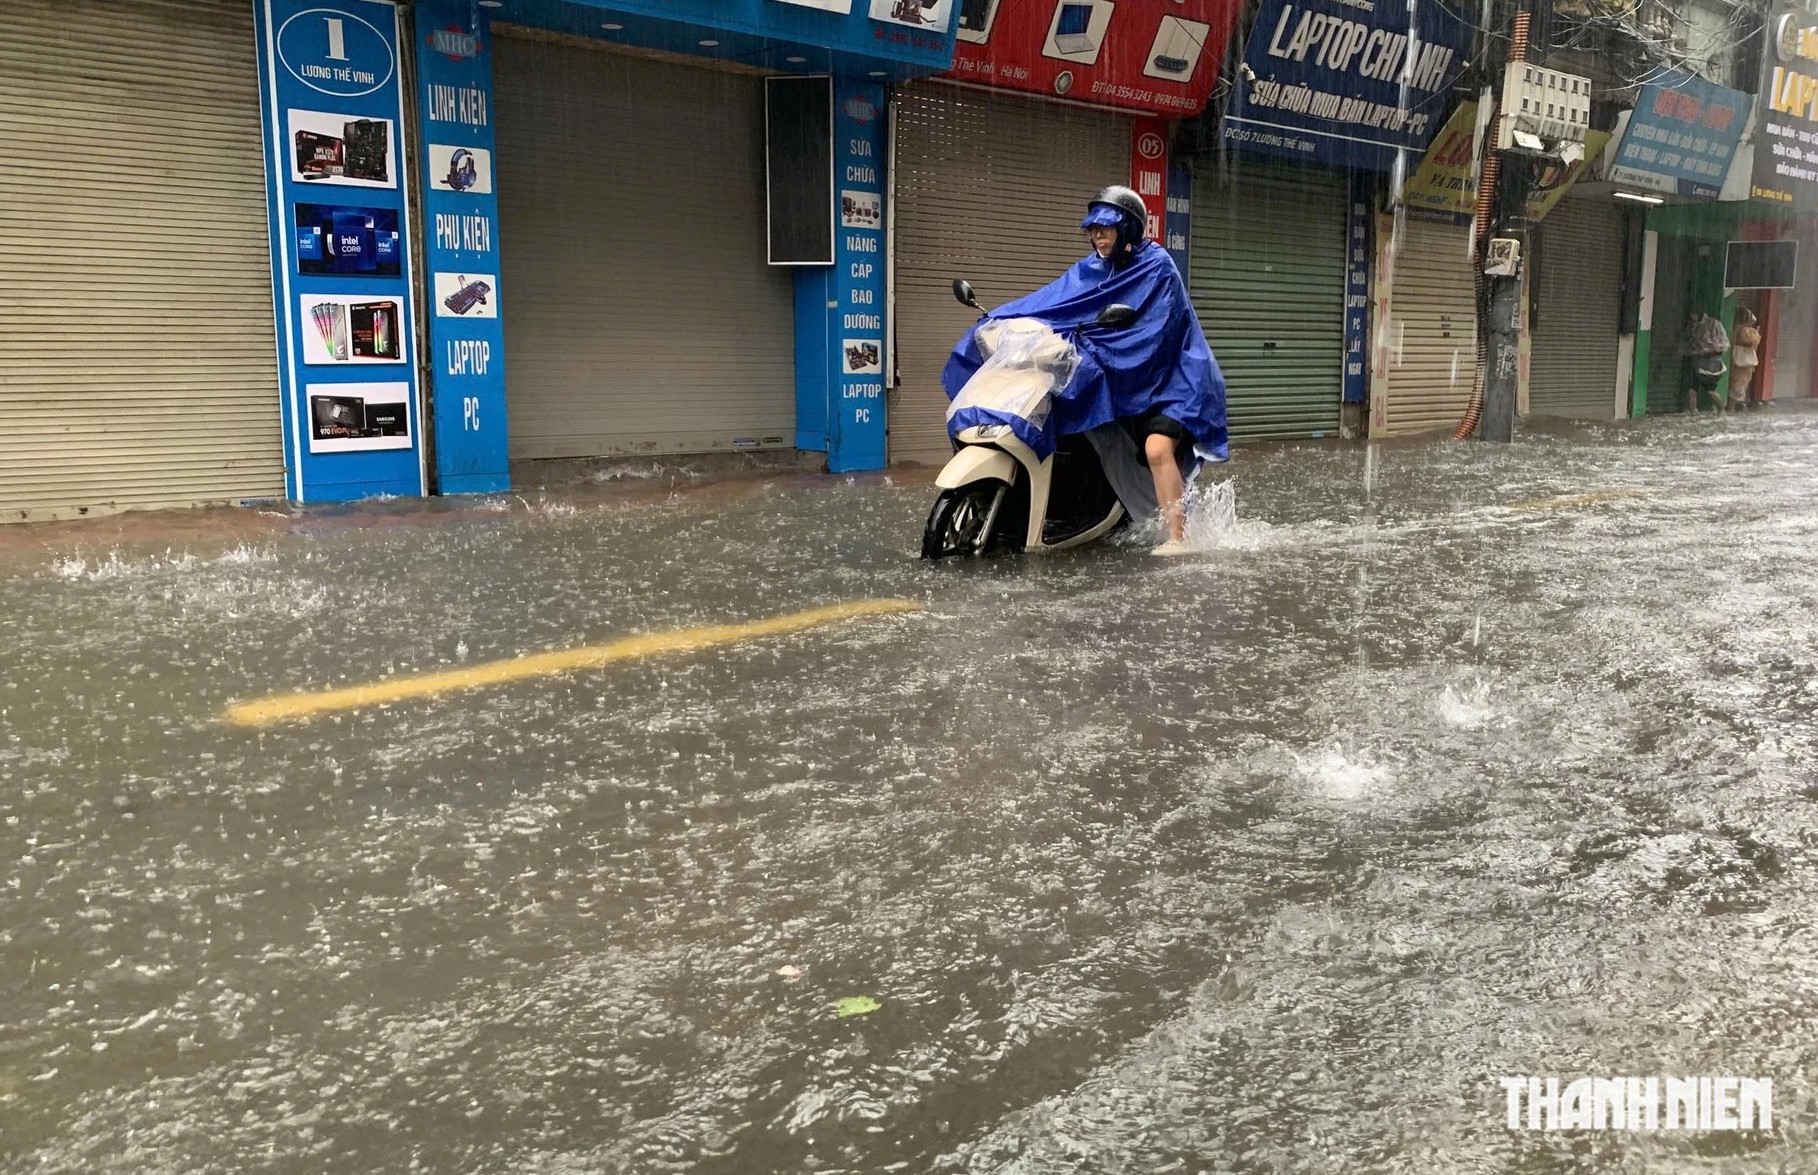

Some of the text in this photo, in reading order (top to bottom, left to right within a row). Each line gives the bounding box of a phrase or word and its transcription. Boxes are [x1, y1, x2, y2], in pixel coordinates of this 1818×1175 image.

[322, 17, 350, 61] 1
[437, 32, 475, 55] MHC
[1268, 4, 1368, 72] LAPTOP
[301, 64, 375, 84] LƯƠNG THẾ VINH
[428, 80, 487, 134] LINH KIỆN
[1250, 73, 1281, 107] SỬA
[1278, 82, 1313, 114] CHỮA
[1308, 90, 1342, 119] MUA
[1337, 94, 1368, 122] BÁN
[1141, 137, 1159, 155] 05
[846, 164, 876, 184] CHỮA
[1139, 170, 1161, 196] LINH
[341, 235, 359, 245] intel
[435, 208, 491, 260] PHỤ KIỆN
[846, 234, 877, 252] NÂNG
[851, 260, 873, 279] CẤP
[1347, 294, 1367, 308] LAPTOP
[844, 311, 881, 330] DƯỠNG
[1353, 317, 1361, 330] PC
[447, 340, 490, 375] LAPTOP
[843, 383, 882, 399] LAPTOP
[464, 397, 480, 431] PC
[855, 408, 870, 423] PC
